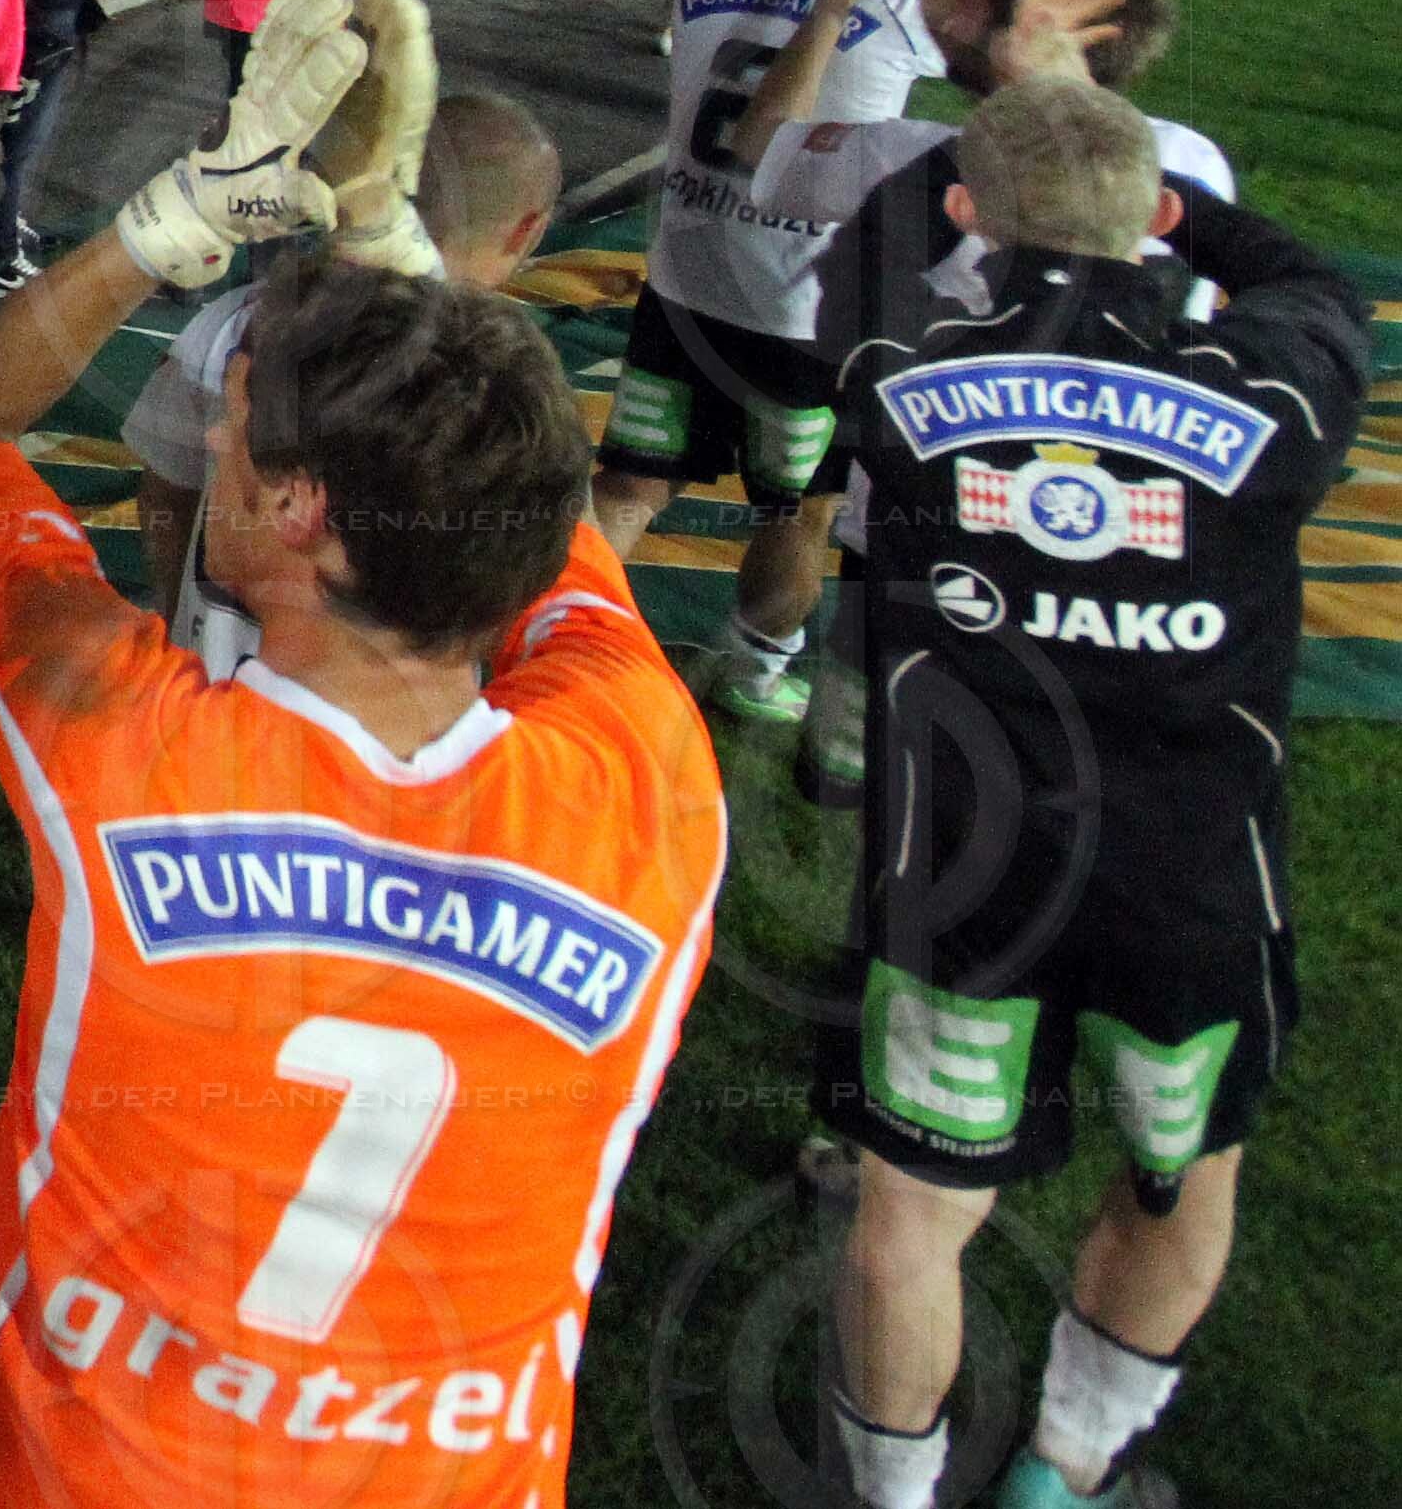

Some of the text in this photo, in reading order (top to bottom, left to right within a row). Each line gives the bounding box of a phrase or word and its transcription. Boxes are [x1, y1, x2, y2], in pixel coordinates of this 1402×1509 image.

[898, 376, 1247, 468] PUNTIGAMER
[1021, 592, 1228, 653] JAKO
[130, 850, 629, 1022] PUNTIGAMER
